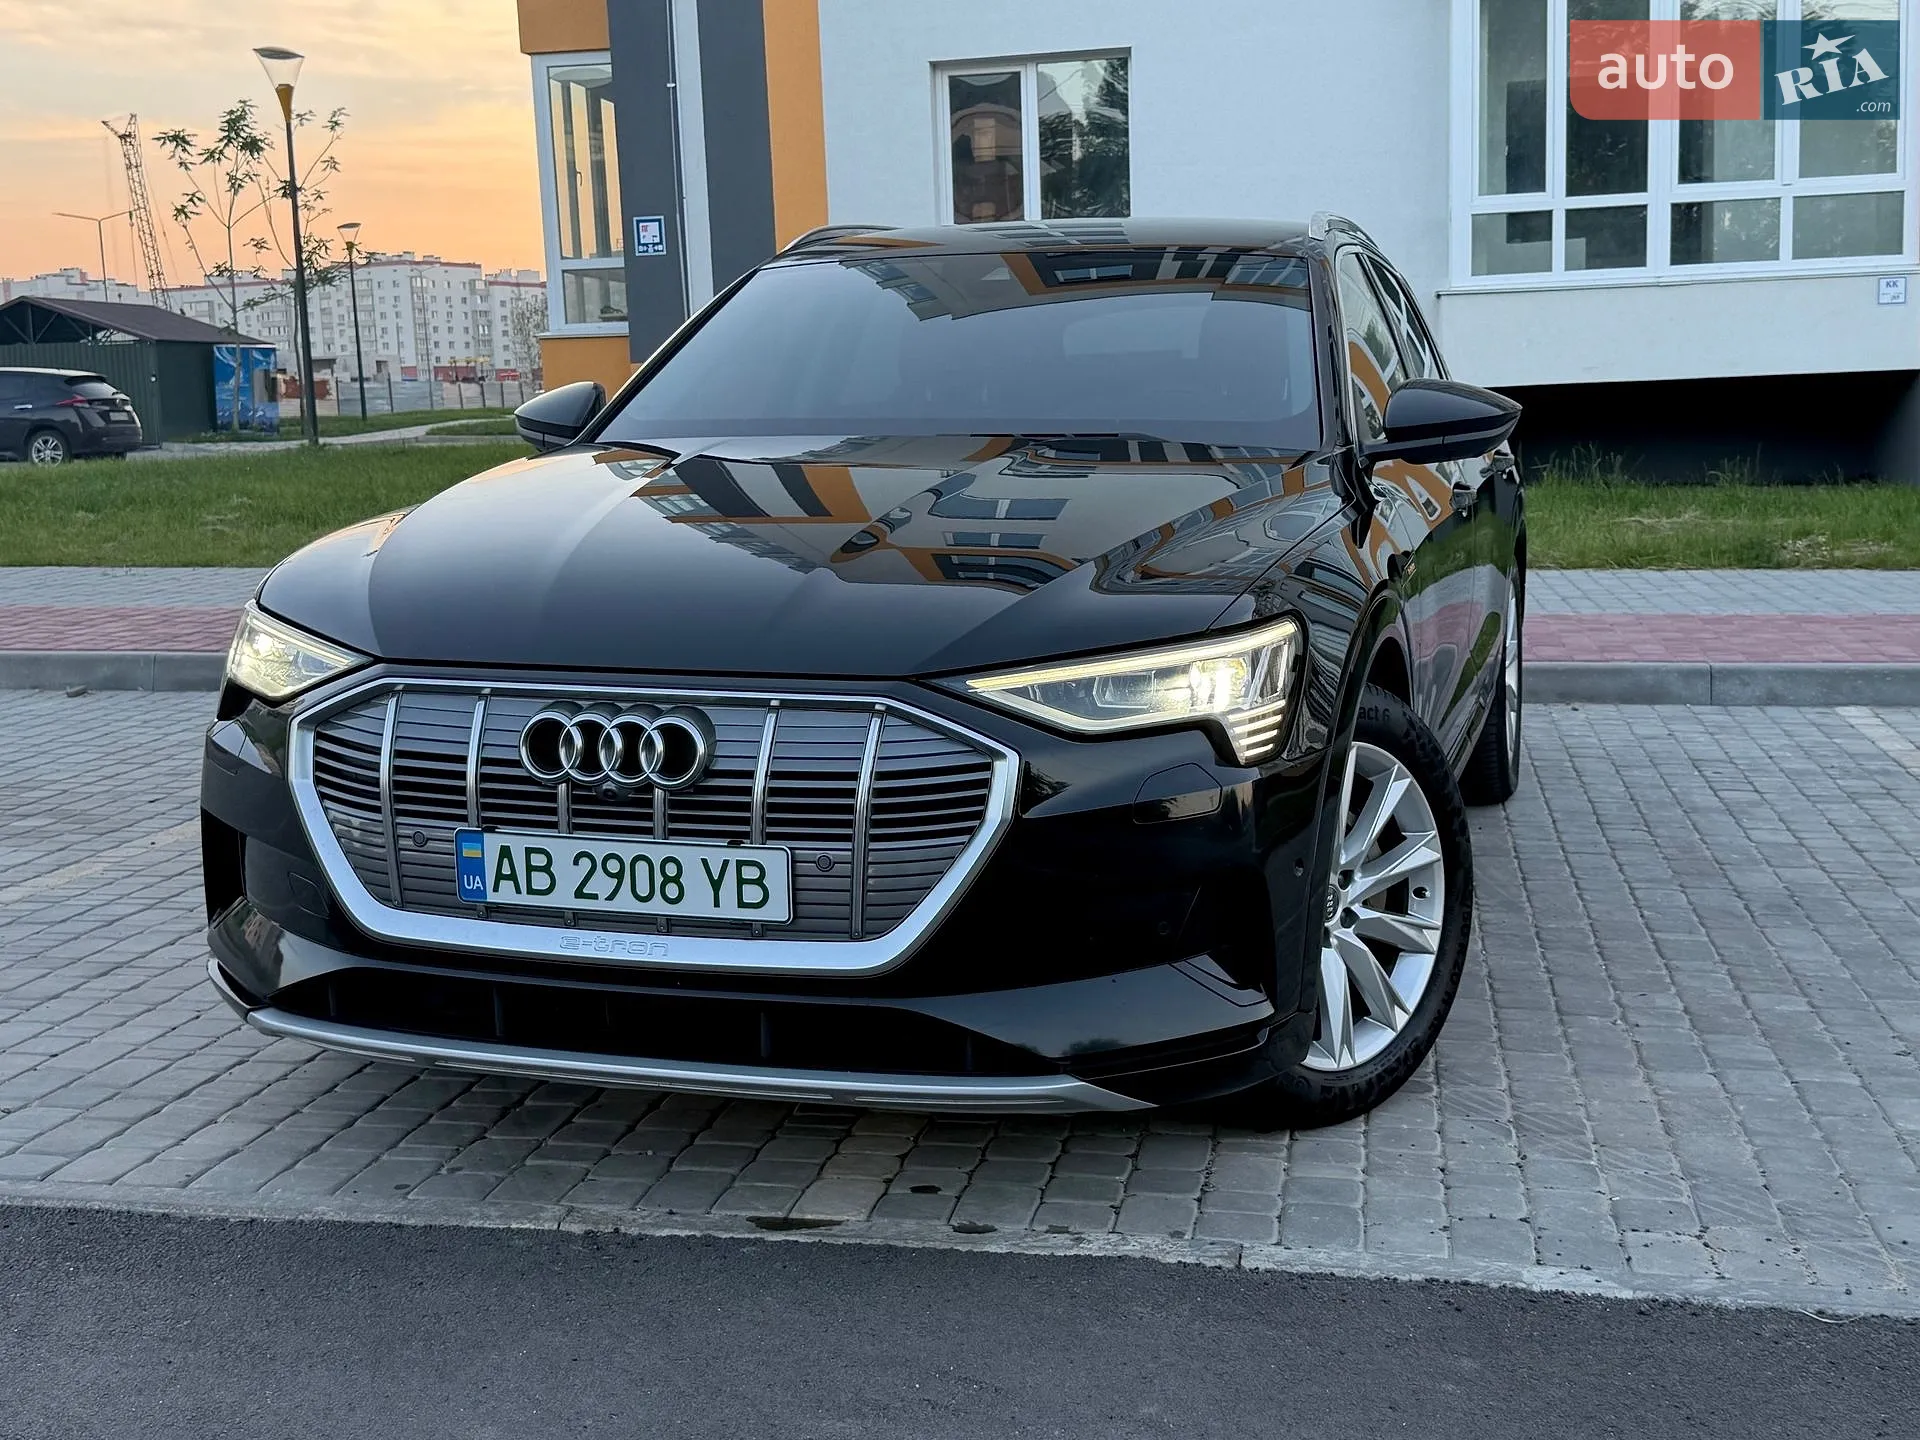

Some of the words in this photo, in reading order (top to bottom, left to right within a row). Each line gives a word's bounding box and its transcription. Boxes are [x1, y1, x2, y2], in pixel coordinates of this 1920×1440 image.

[463, 874, 484, 891] UA
[492, 844, 557, 896] AB
[572, 850, 685, 905] 2908
[700, 857, 770, 909] YB
[559, 935, 669, 957] e-tron
